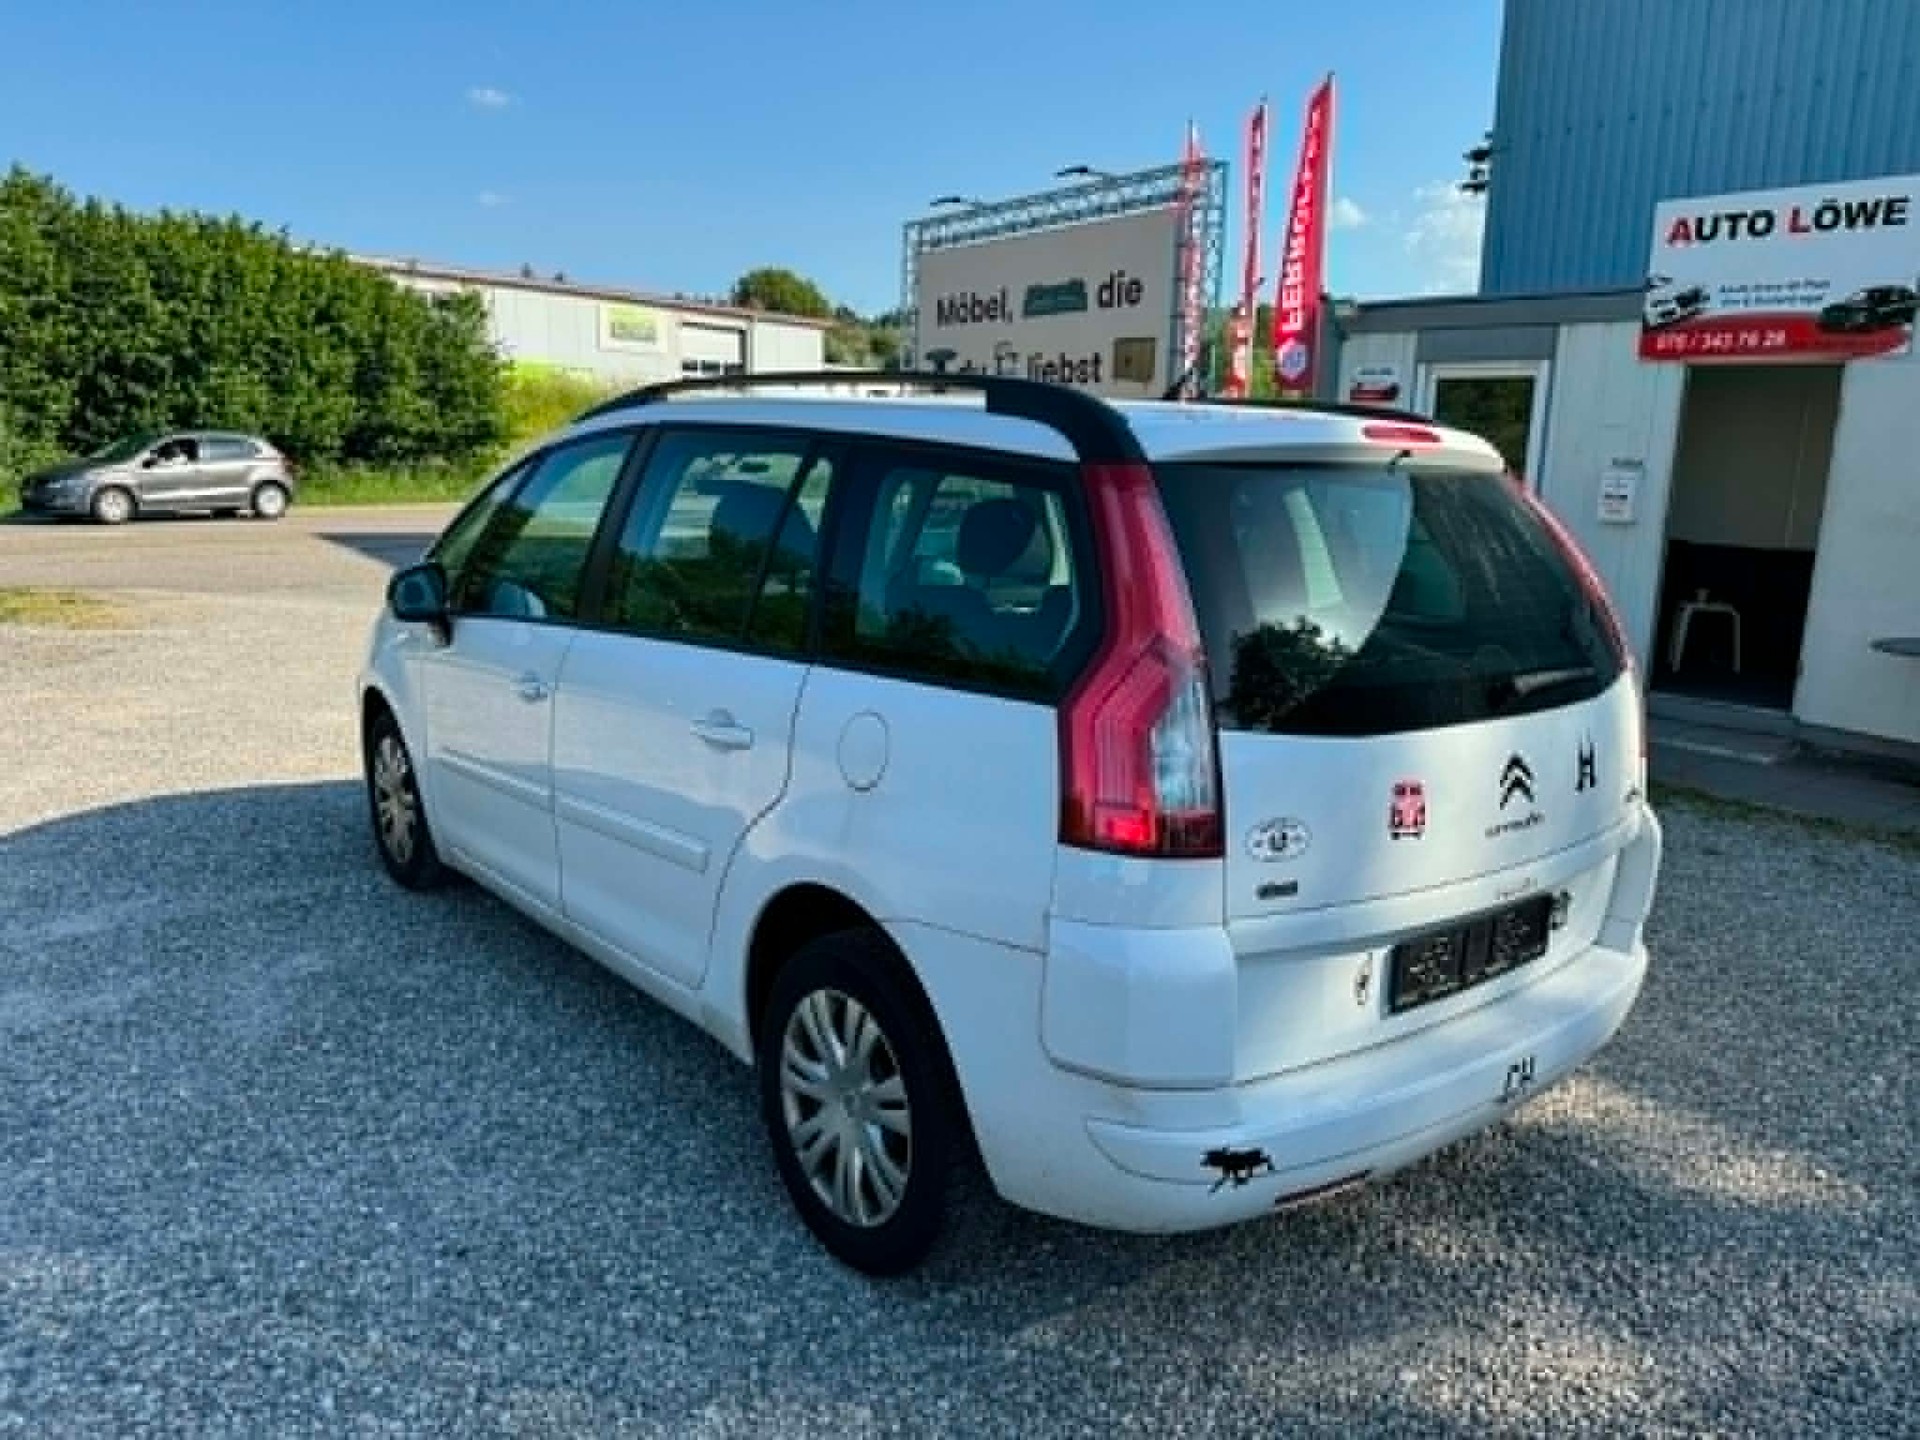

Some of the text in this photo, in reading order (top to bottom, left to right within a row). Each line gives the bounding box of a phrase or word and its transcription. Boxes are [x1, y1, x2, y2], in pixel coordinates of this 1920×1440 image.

[1667, 196, 1910, 247] AUTO LÖWE
[936, 270, 1145, 328] Möbel, die
